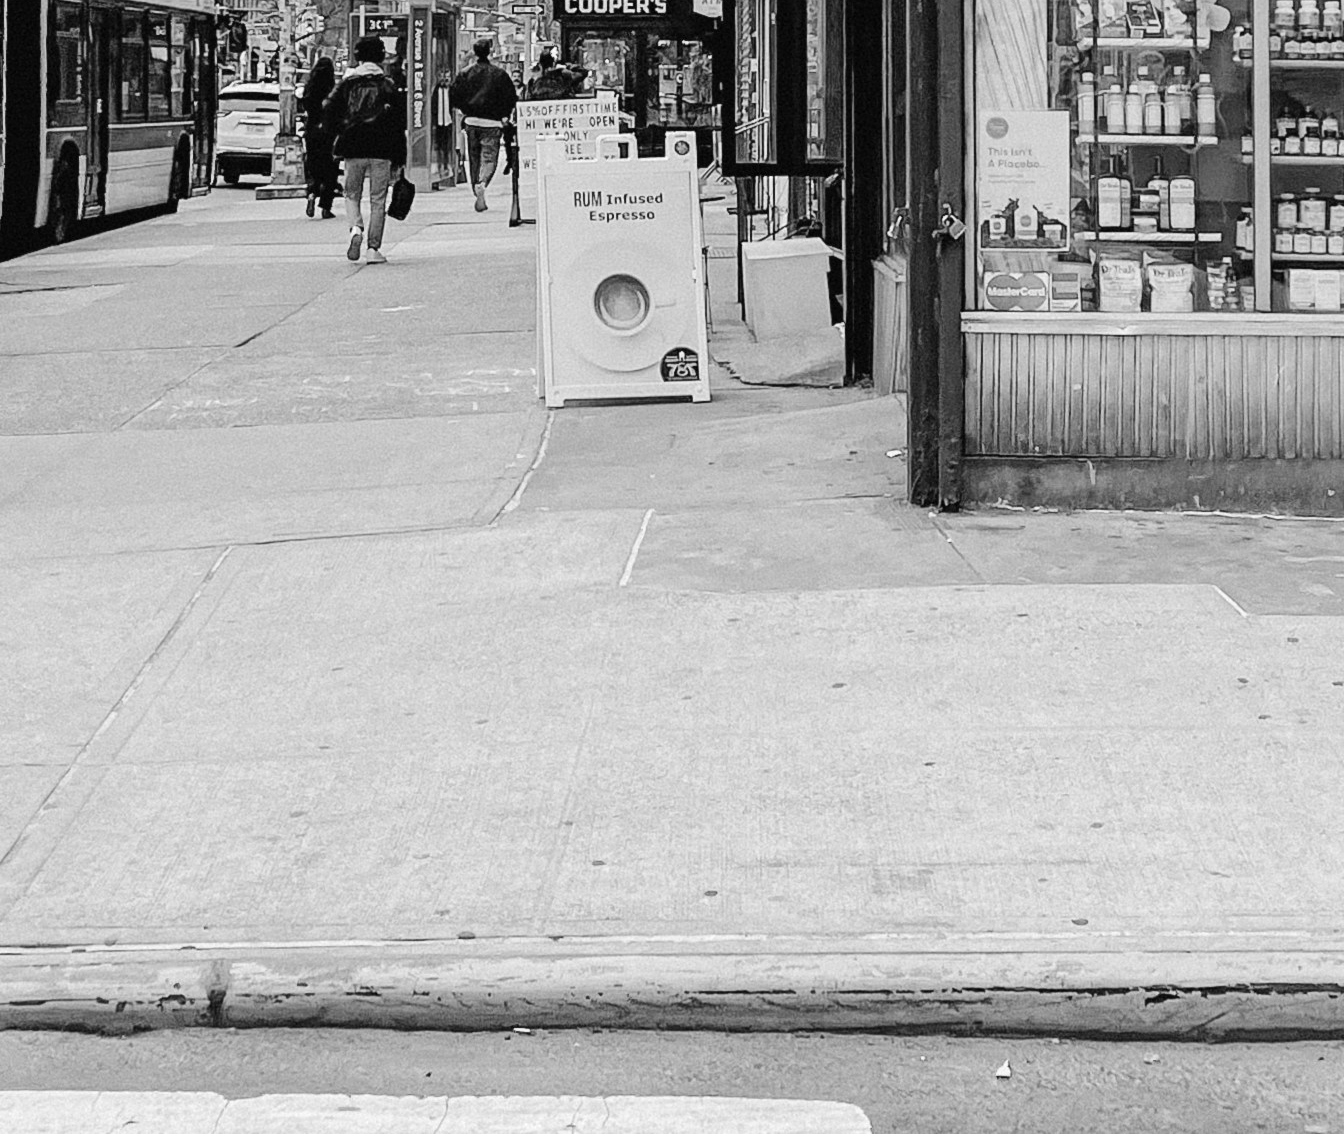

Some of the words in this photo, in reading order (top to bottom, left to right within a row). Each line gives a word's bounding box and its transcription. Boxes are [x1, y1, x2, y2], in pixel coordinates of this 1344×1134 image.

[525, 119, 536, 129] HI
[544, 117, 574, 129] WE'RE
[589, 116, 615, 127] OPEN
[987, 147, 1008, 156] This
[573, 191, 602, 208] RUM
[606, 192, 663, 206] Infused
[589, 210, 656, 223] Espresso
[987, 285, 1047, 298] MasterCard
